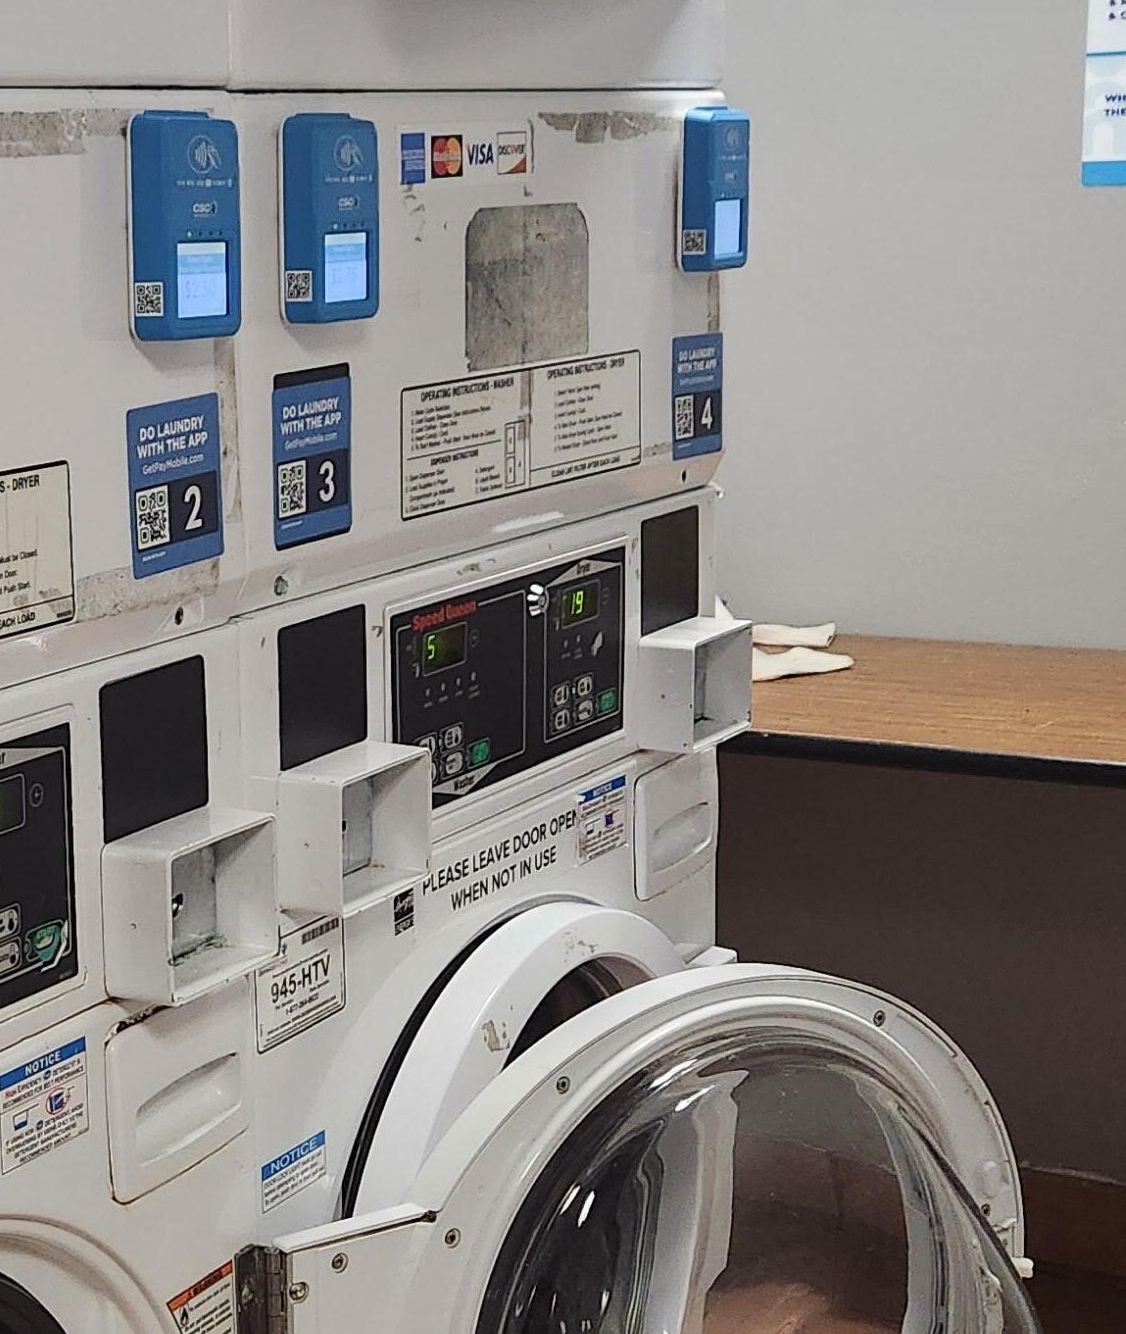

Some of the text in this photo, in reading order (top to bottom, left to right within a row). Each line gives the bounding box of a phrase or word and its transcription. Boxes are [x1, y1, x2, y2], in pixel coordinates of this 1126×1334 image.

[467, 143, 494, 165] VISA
[283, 397, 339, 419] DO LAUNDRY
[701, 397, 713, 430] 4
[139, 415, 205, 442] DO LAUNDRY
[280, 411, 342, 435] WITH THE APP
[137, 431, 208, 459] WITH THE APP
[142, 453, 204, 475] GetPayMobile.com
[12, 474, 40, 492] DRYER
[319, 460, 335, 502] 3
[184, 485, 203, 531] 2
[570, 590, 584, 615] 19
[17, 611, 36, 625] LOAD
[412, 601, 477, 633] Speed Queen
[426, 634, 436, 660] 5
[473, 839, 510, 873] LEAVE
[513, 823, 547, 853] DOOR
[451, 845, 557, 911] WHEN NOT IN USE
[270, 954, 330, 1004] 945-HTV
[24, 1051, 62, 1077] NOTICE
[270, 1137, 318, 1173] NOTICE
